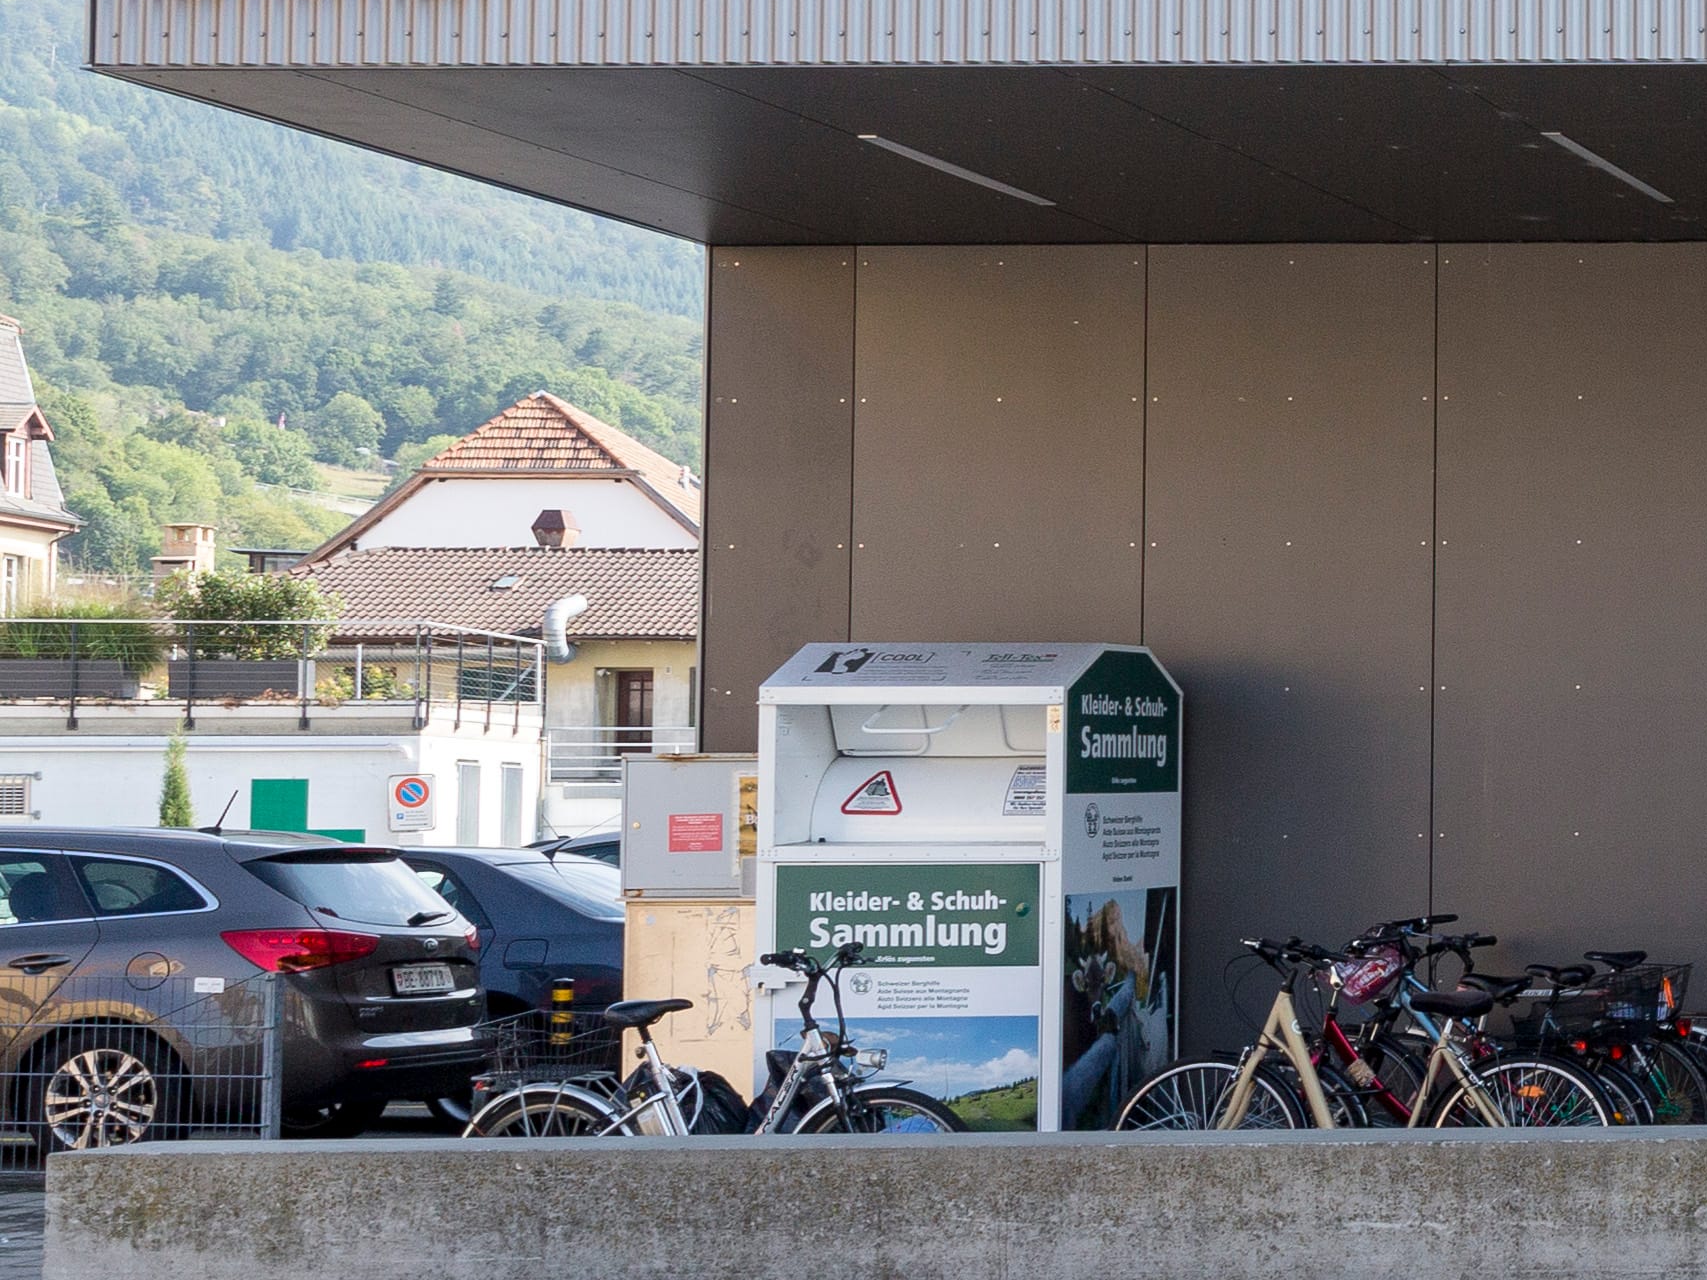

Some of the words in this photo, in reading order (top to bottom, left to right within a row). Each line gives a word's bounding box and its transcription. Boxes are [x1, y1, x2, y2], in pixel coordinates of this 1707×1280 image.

[1081, 693, 1123, 716] Kleider-
[1125, 696, 1134, 717] &
[1135, 696, 1168, 717] Schuh-
[1081, 724, 1167, 767] Sammlung
[809, 891, 900, 912] Kleider-
[907, 891, 924, 911] &
[930, 890, 1008, 911] Schuh-
[809, 914, 1007, 955] Sammlung
